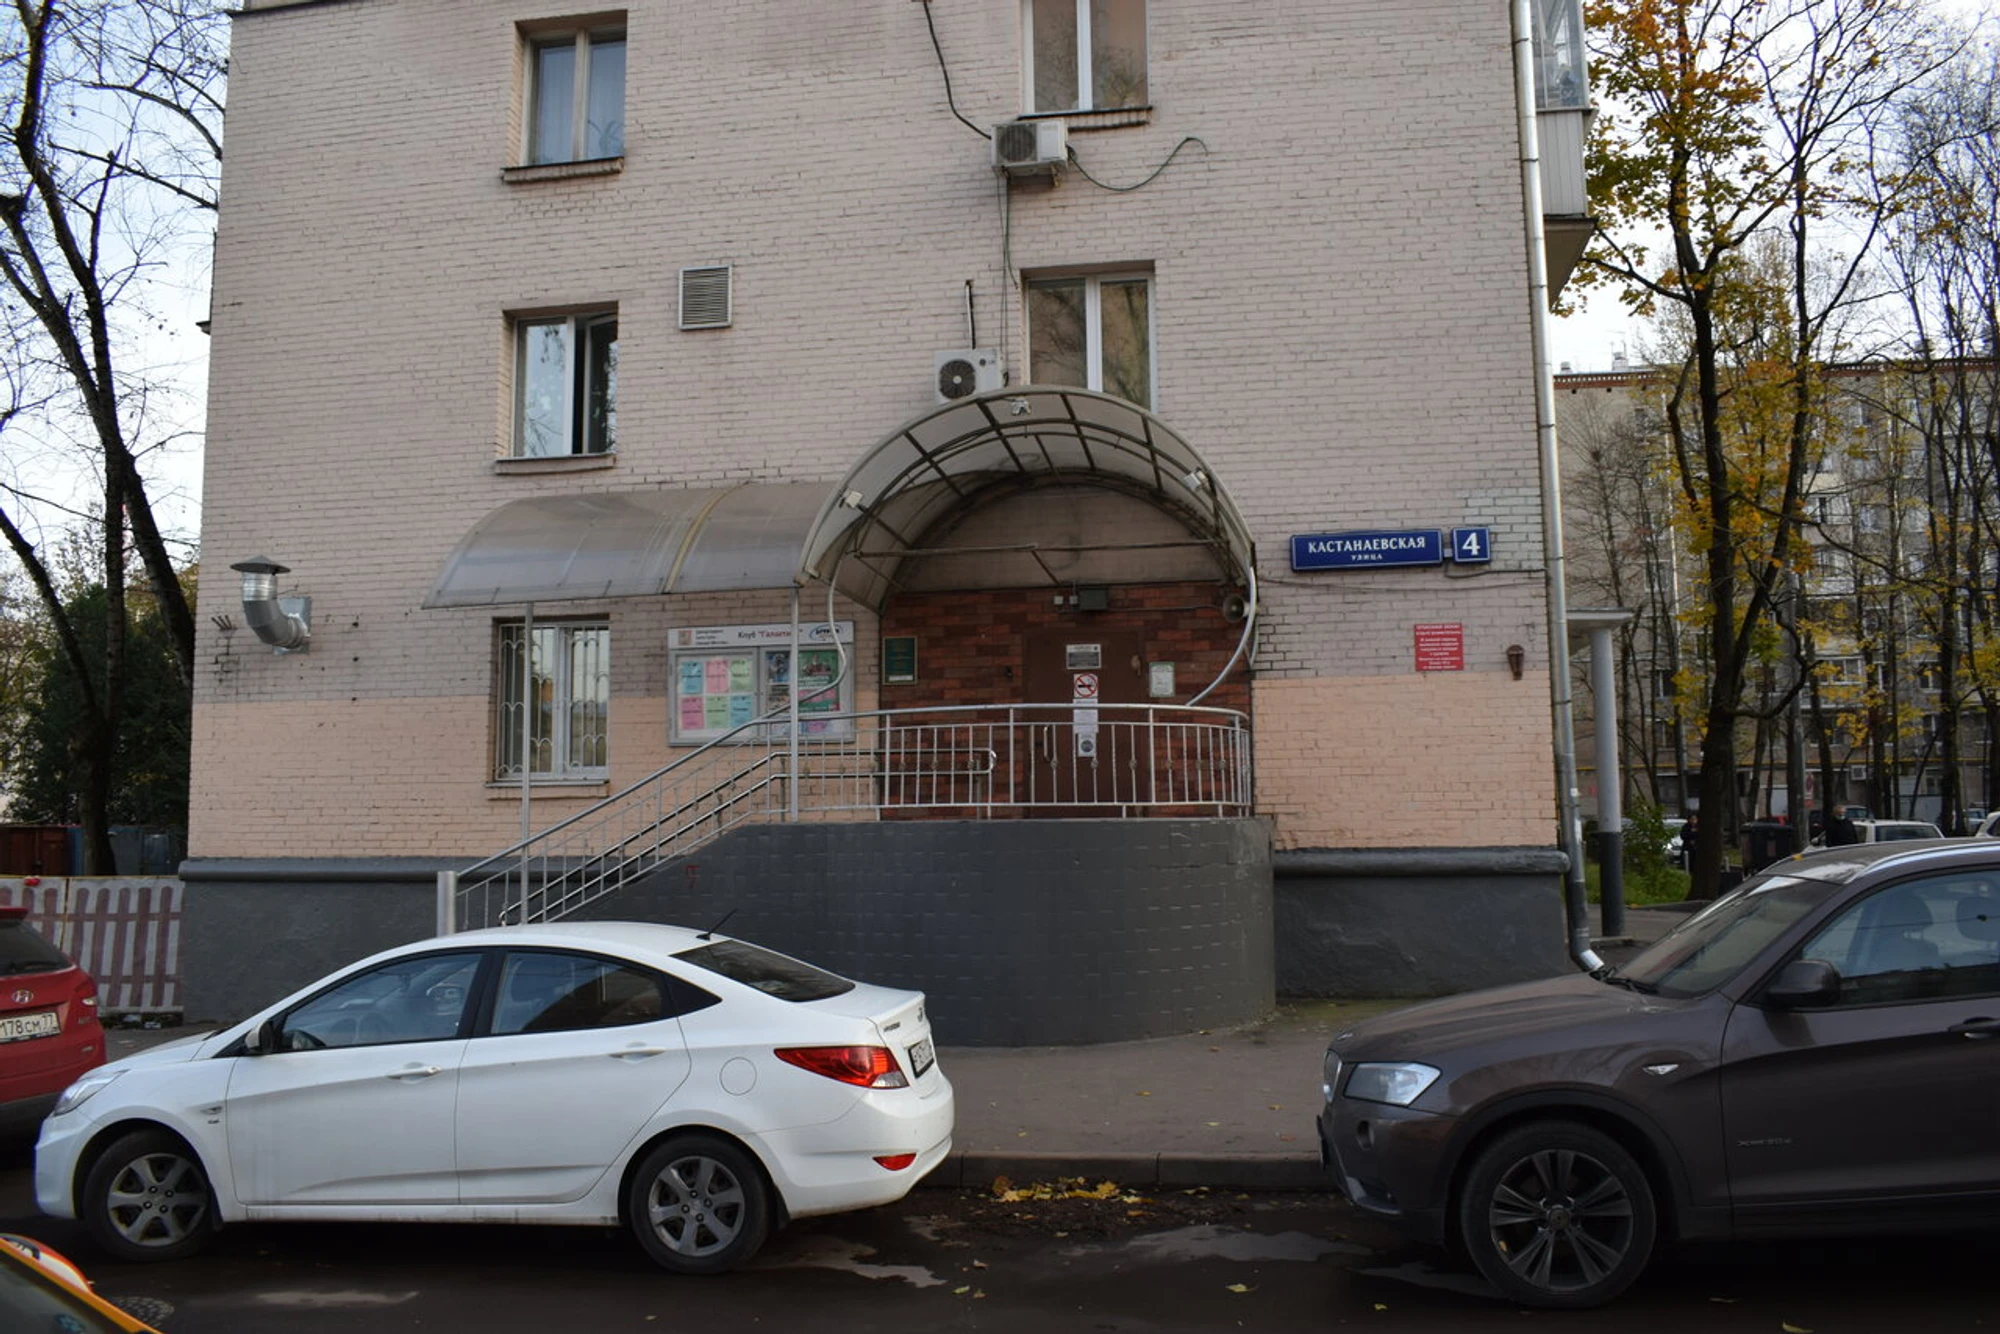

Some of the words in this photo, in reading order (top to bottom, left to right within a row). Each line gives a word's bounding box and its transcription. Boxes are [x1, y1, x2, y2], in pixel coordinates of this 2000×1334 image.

[1308, 536, 1426, 553] КАСТАНАЕВСКАЯ
[1462, 532, 1481, 556] 4
[1351, 553, 1383, 561] УЛИЦА
